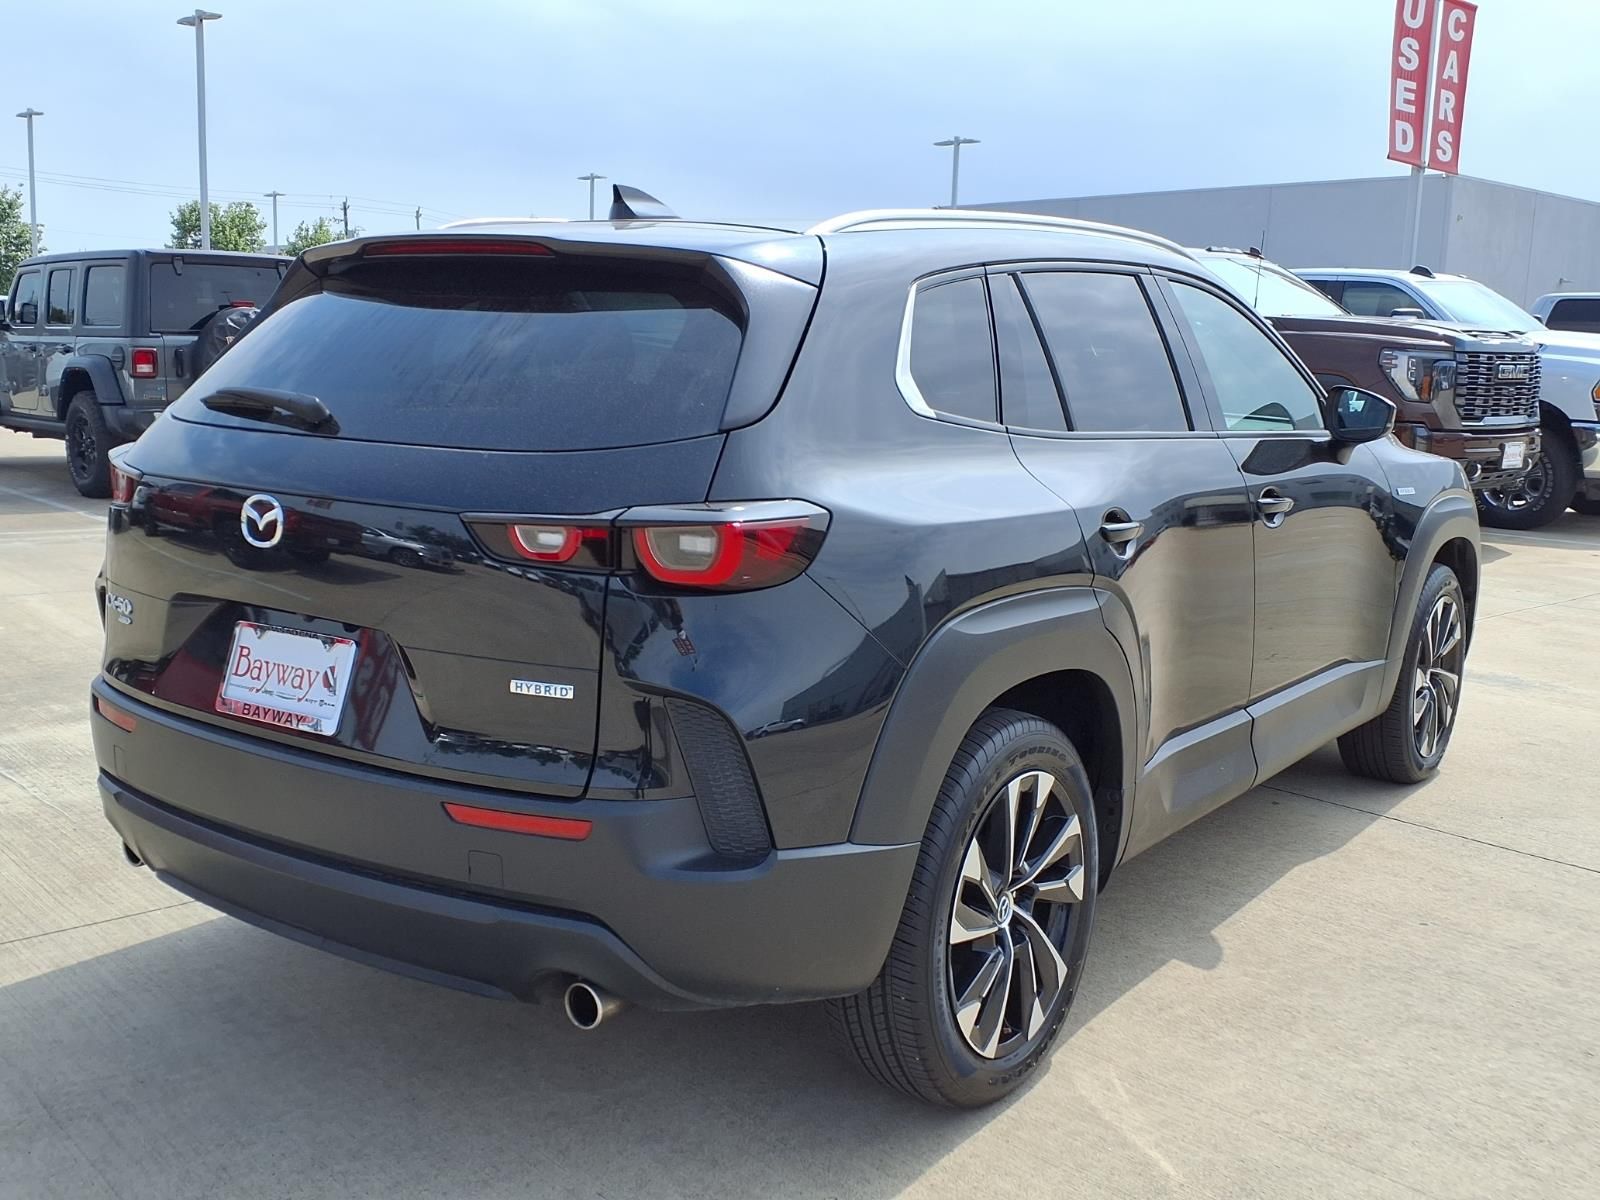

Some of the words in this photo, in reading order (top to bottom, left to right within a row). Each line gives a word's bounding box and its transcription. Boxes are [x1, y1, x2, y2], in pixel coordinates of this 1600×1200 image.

[1395, 0, 1426, 153] USED
[1436, 8, 1467, 162] CARS
[1499, 365, 1529, 379] GMC
[232, 645, 320, 702] Bayway
[242, 702, 304, 728] BAYWAY
